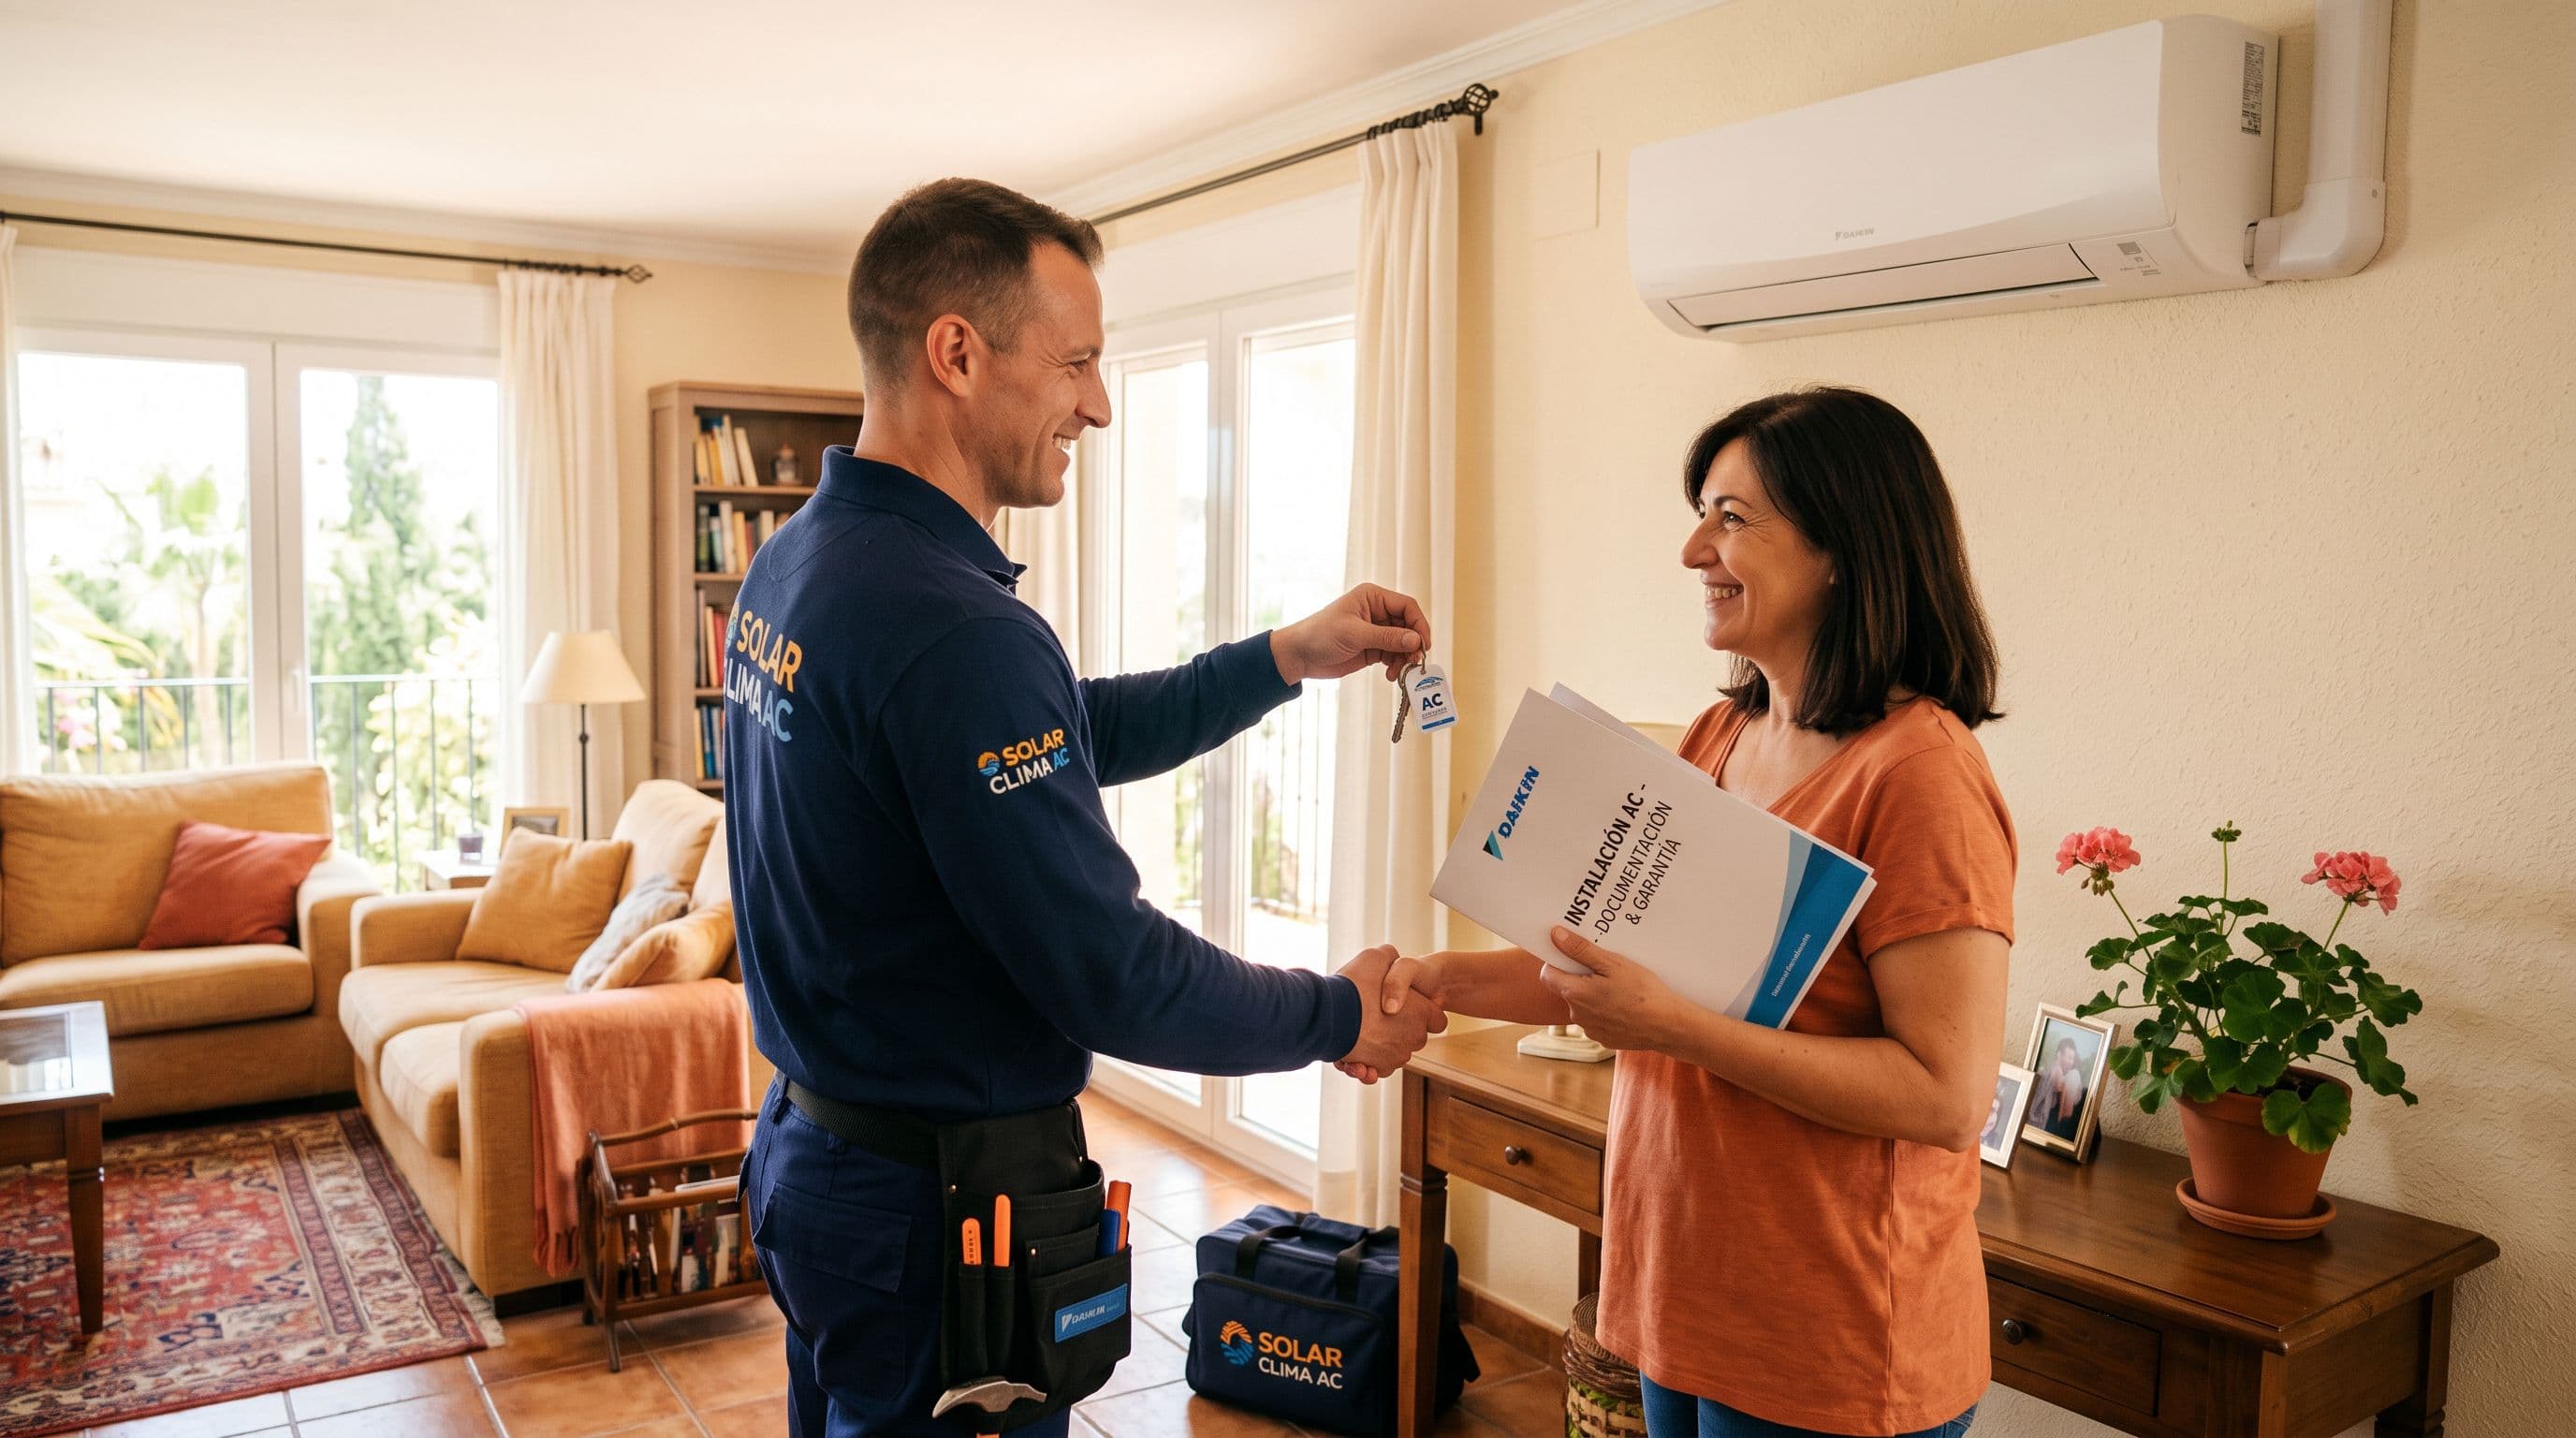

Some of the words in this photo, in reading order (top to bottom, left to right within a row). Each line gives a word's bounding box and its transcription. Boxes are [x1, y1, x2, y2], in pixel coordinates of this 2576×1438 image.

[736, 610, 803, 694] SOLAR
[762, 690, 794, 742] AC
[1422, 693, 1443, 711] AC
[1002, 728, 1065, 767] SOLAR
[989, 756, 1054, 795] CLIMA
[1053, 747, 1070, 771] AC
[1564, 817, 1632, 926] INSTALACIÓN
[1621, 792, 1645, 819] AC
[1632, 838, 1682, 910] GARANTÍA
[1625, 913, 1642, 926] &
[1258, 1331, 1343, 1369] SOLAR
[1258, 1357, 1313, 1385] CLIMA
[1316, 1371, 1343, 1389] AC
